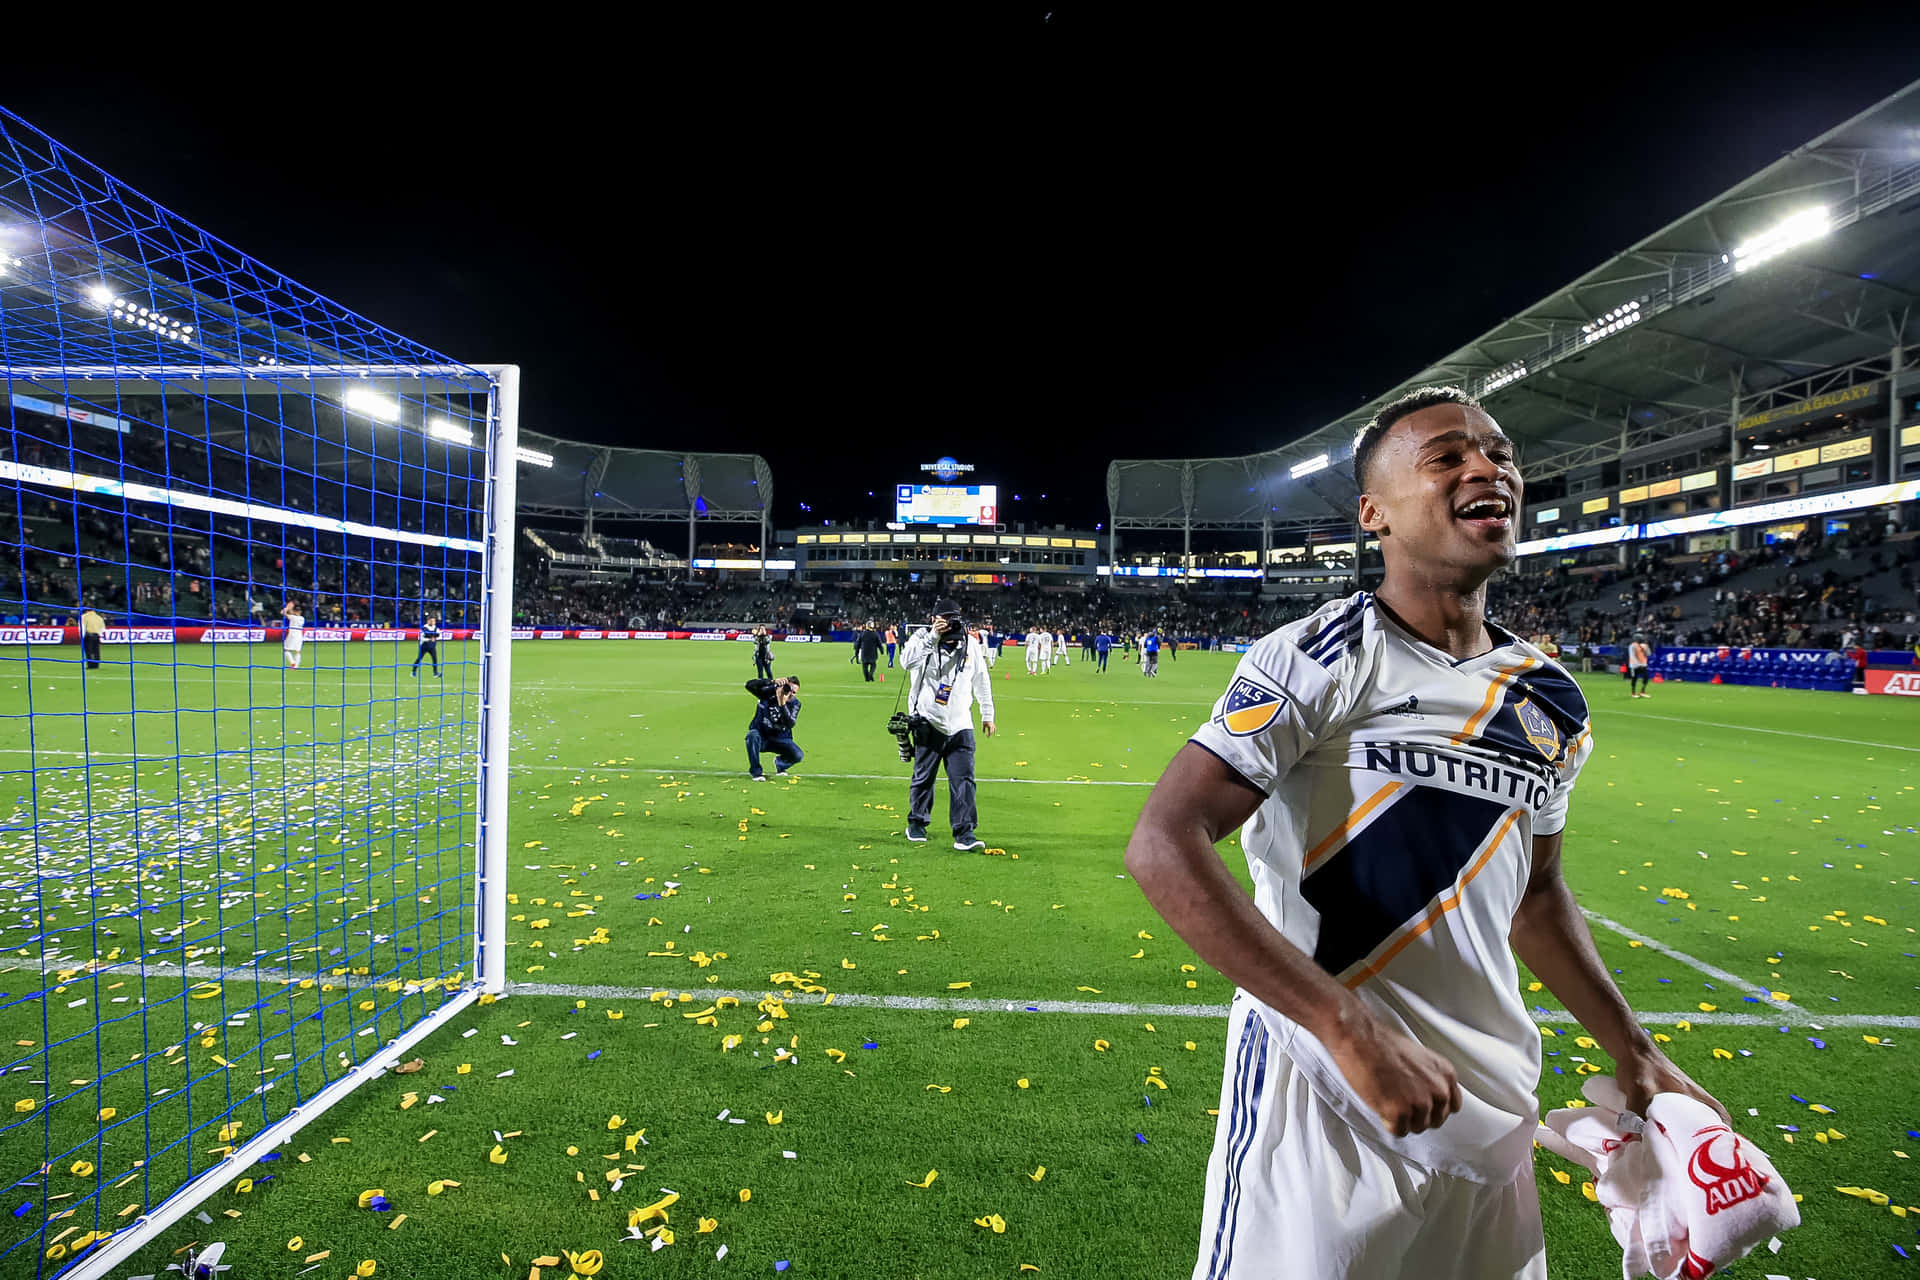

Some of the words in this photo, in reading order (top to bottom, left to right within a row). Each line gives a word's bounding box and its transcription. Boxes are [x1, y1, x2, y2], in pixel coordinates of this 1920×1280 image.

[0, 630, 61, 641] OCARE
[100, 630, 172, 641] ADVOCARE
[1236, 683, 1264, 702] MLS
[1527, 716, 1553, 736] LA
[1366, 742, 1551, 811] NUTRITIO
